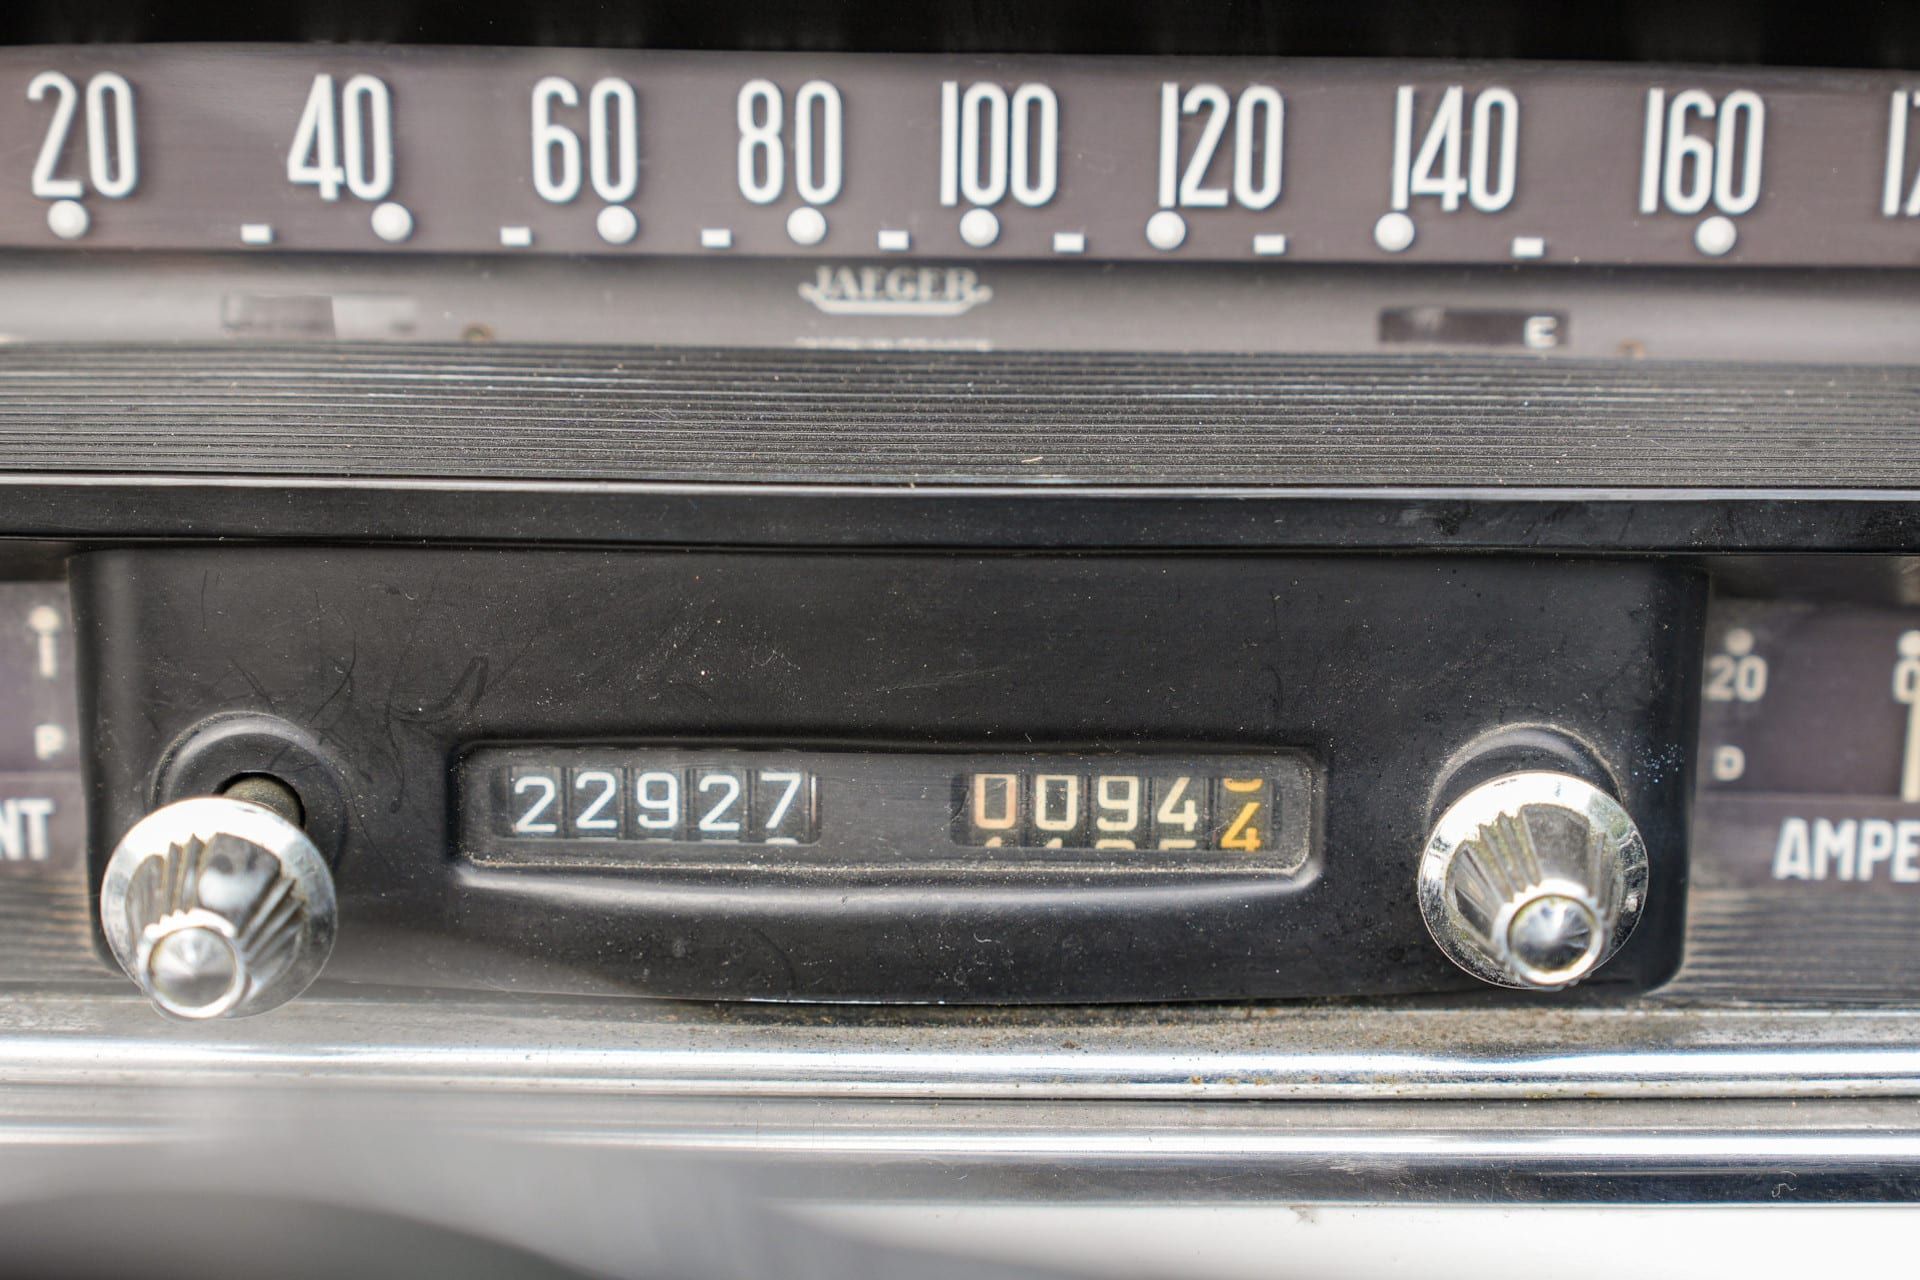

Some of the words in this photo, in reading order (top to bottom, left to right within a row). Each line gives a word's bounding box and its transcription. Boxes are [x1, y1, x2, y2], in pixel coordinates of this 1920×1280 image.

[28, 71, 137, 198] 20
[288, 74, 394, 200] 40
[532, 77, 638, 202] 60
[738, 79, 843, 203] 80
[940, 81, 1058, 206] 100
[1159, 82, 1284, 209] 120
[1391, 86, 1519, 212] 140
[1639, 88, 1765, 215] 160
[815, 265, 978, 301] JAEGER
[1706, 655, 1768, 702] 20
[514, 771, 801, 833] 22927
